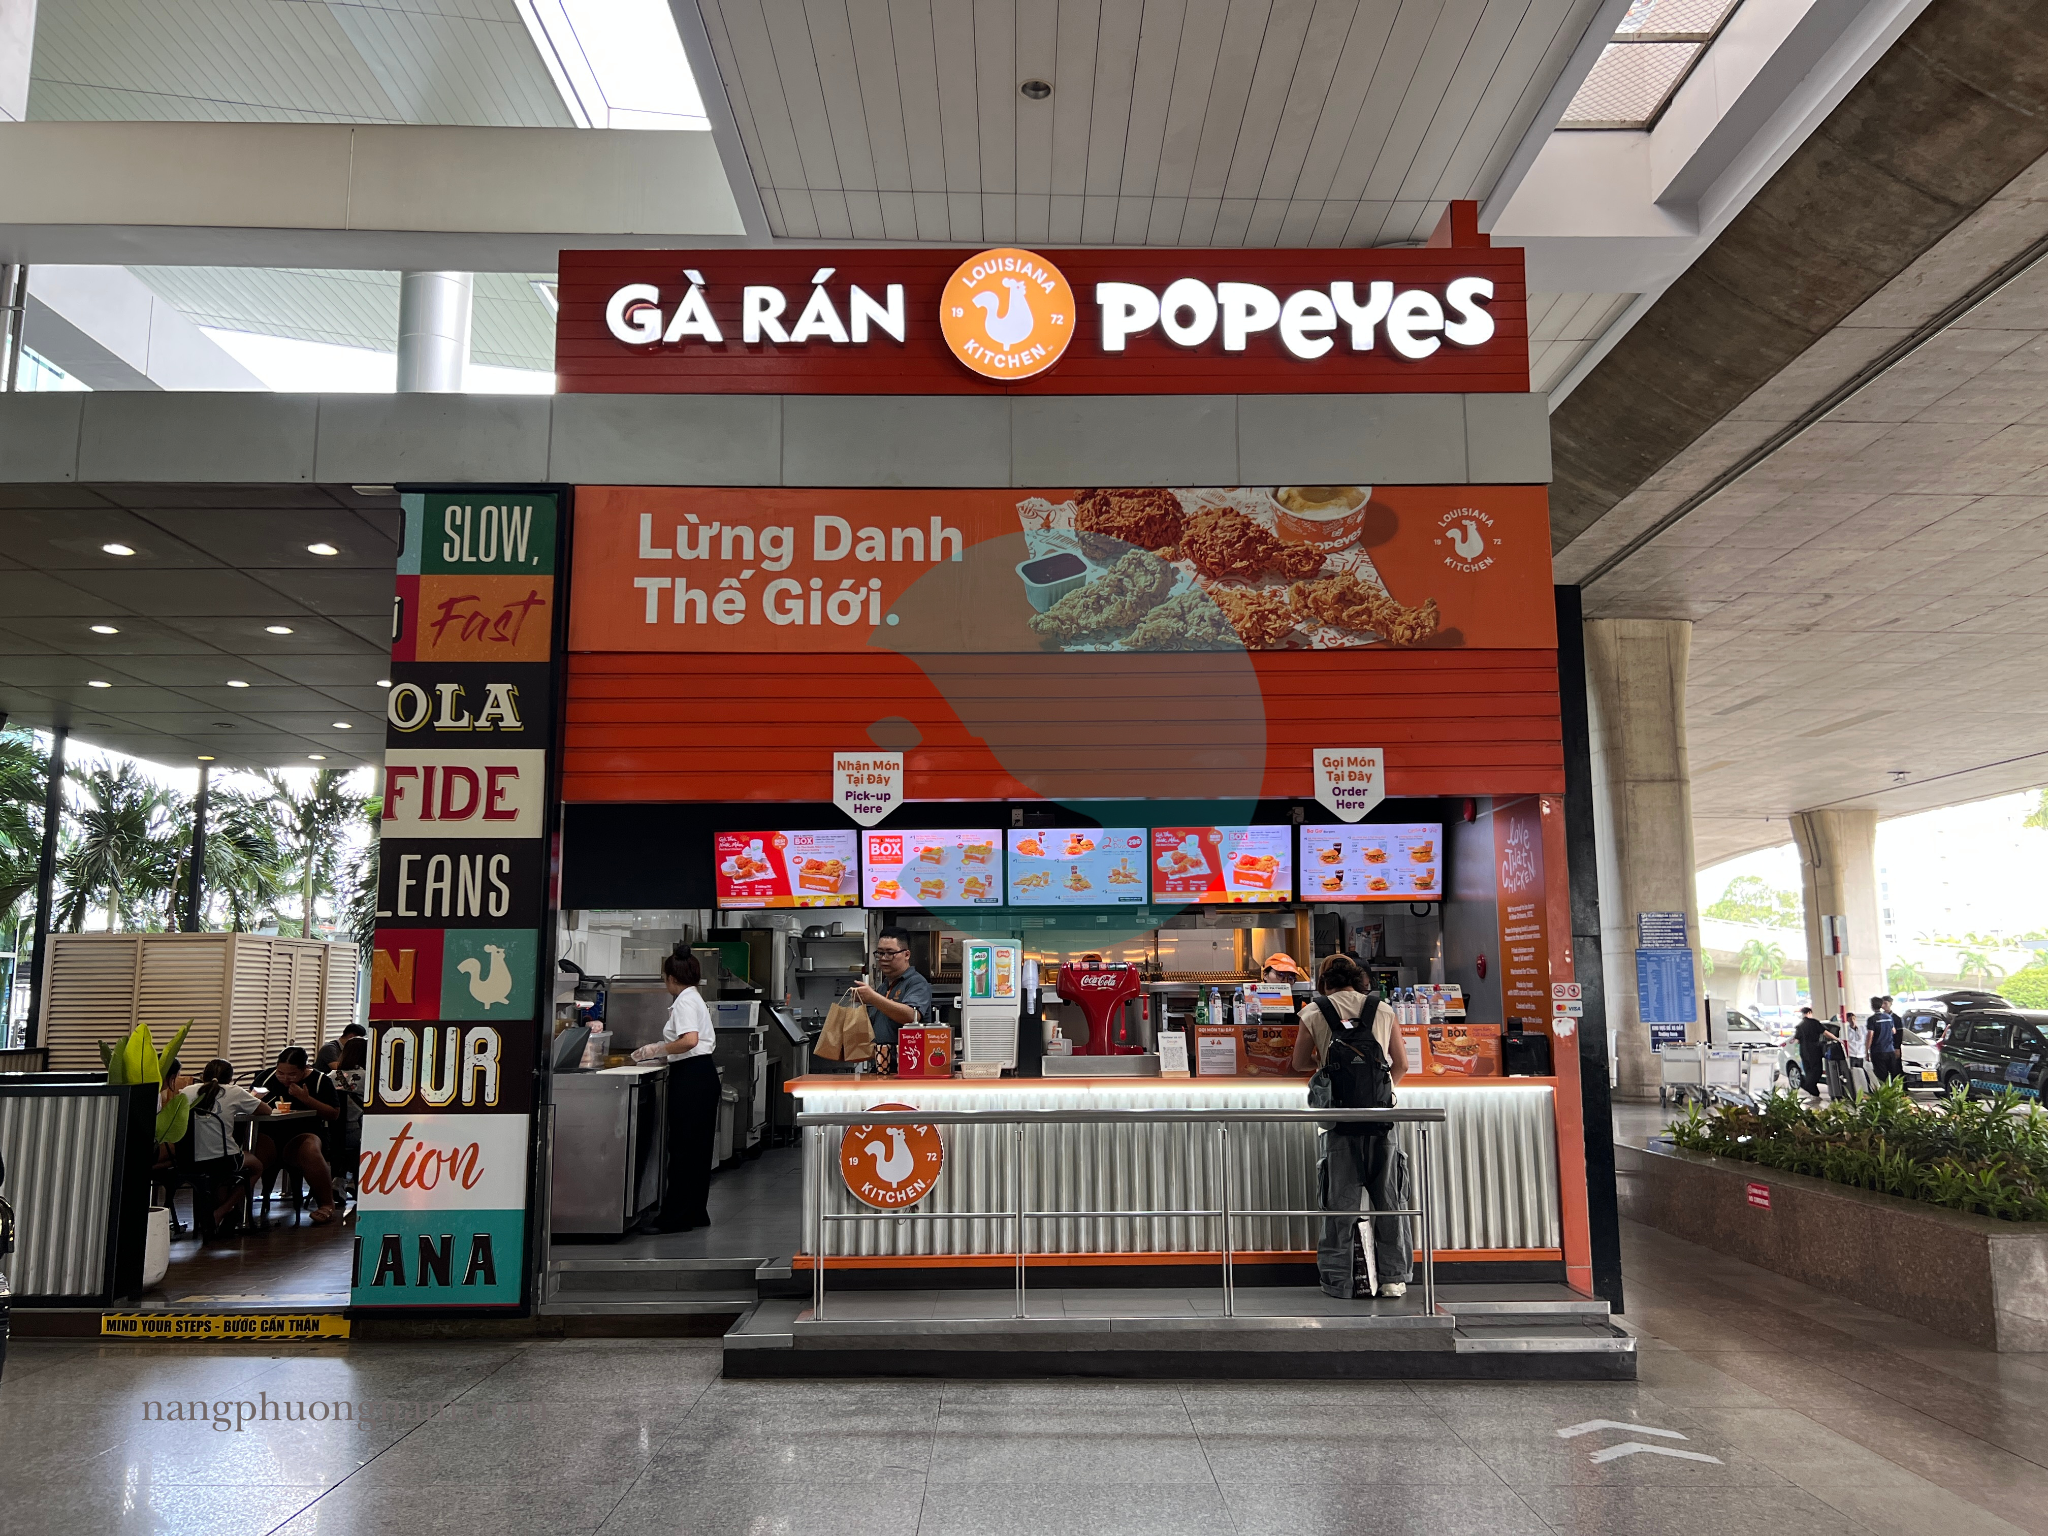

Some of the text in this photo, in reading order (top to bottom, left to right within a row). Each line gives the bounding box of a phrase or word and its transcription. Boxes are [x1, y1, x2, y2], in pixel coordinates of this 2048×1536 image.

[962, 258, 1055, 294] LOUISIANA
[606, 269, 724, 344] GÀ
[743, 268, 905, 342] RÁN
[951, 307, 1064, 325] 19 72
[963, 339, 1046, 368] KITCHEN
[1438, 508, 1494, 527] LOUISIANA
[442, 505, 540, 566] SLOW,
[638, 513, 963, 572] Lừng Danh
[1444, 557, 1494, 572] KITCHEN
[633, 569, 900, 626] Thế Giới.
[430, 589, 546, 648] Fast
[837, 760, 900, 773] Nhận Món
[1322, 756, 1375, 770] Gọi Món
[846, 773, 890, 787] Tại Đây
[1326, 770, 1372, 784] Tại Đây
[382, 766, 520, 822] FIDE
[845, 790, 891, 802] Pick-up
[1332, 786, 1368, 796] Order
[854, 803, 882, 813] Here
[1336, 799, 1365, 809] Here
[871, 843, 901, 855] BOX
[1262, 1030, 1283, 1038] BOX
[1447, 1029, 1467, 1037] BOX
[849, 1153, 937, 1166] 19 72
[861, 1179, 926, 1203] KITCHEN
[106, 1319, 137, 1332] MIND
[141, 1319, 172, 1332] YOUR
[175, 1319, 212, 1332] STEPS
[223, 1317, 257, 1332] BƯỚC
